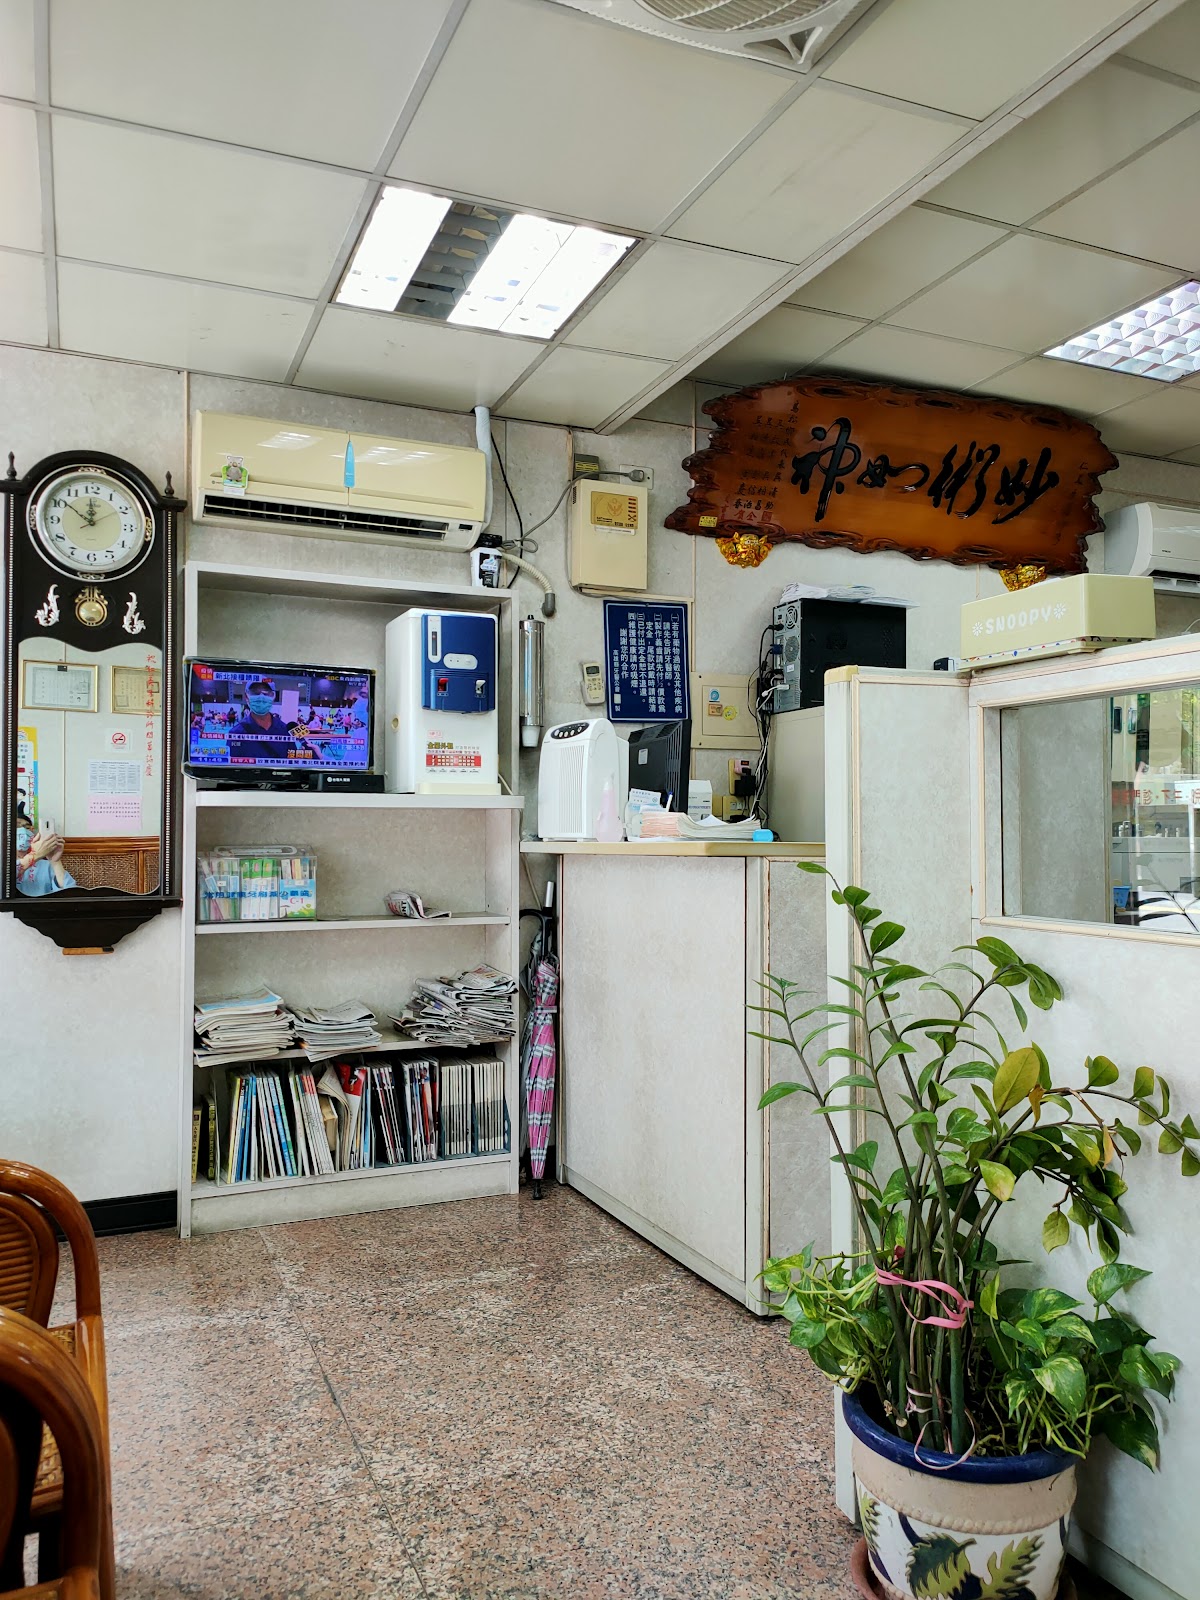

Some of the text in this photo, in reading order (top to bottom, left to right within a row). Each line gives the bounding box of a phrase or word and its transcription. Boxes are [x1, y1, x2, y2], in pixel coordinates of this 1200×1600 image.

[67, 488, 79, 497] 11
[84, 485, 101, 495] 12
[108, 493, 113, 501] 1
[52, 498, 67, 508] 10
[119, 505, 128, 515] 2
[50, 515, 61, 524] 9
[123, 523, 134, 533] 3
[55, 533, 65, 542] 8
[117, 540, 128, 548] 4
[69, 546, 77, 556] 7
[105, 550, 114, 559] 5
[87, 553, 97, 562] 6
[985, 605, 1052, 635] SNOOPY
[619, 628, 629, 679] 謝謝您的合作
[287, 749, 313, 759] 沒問題
